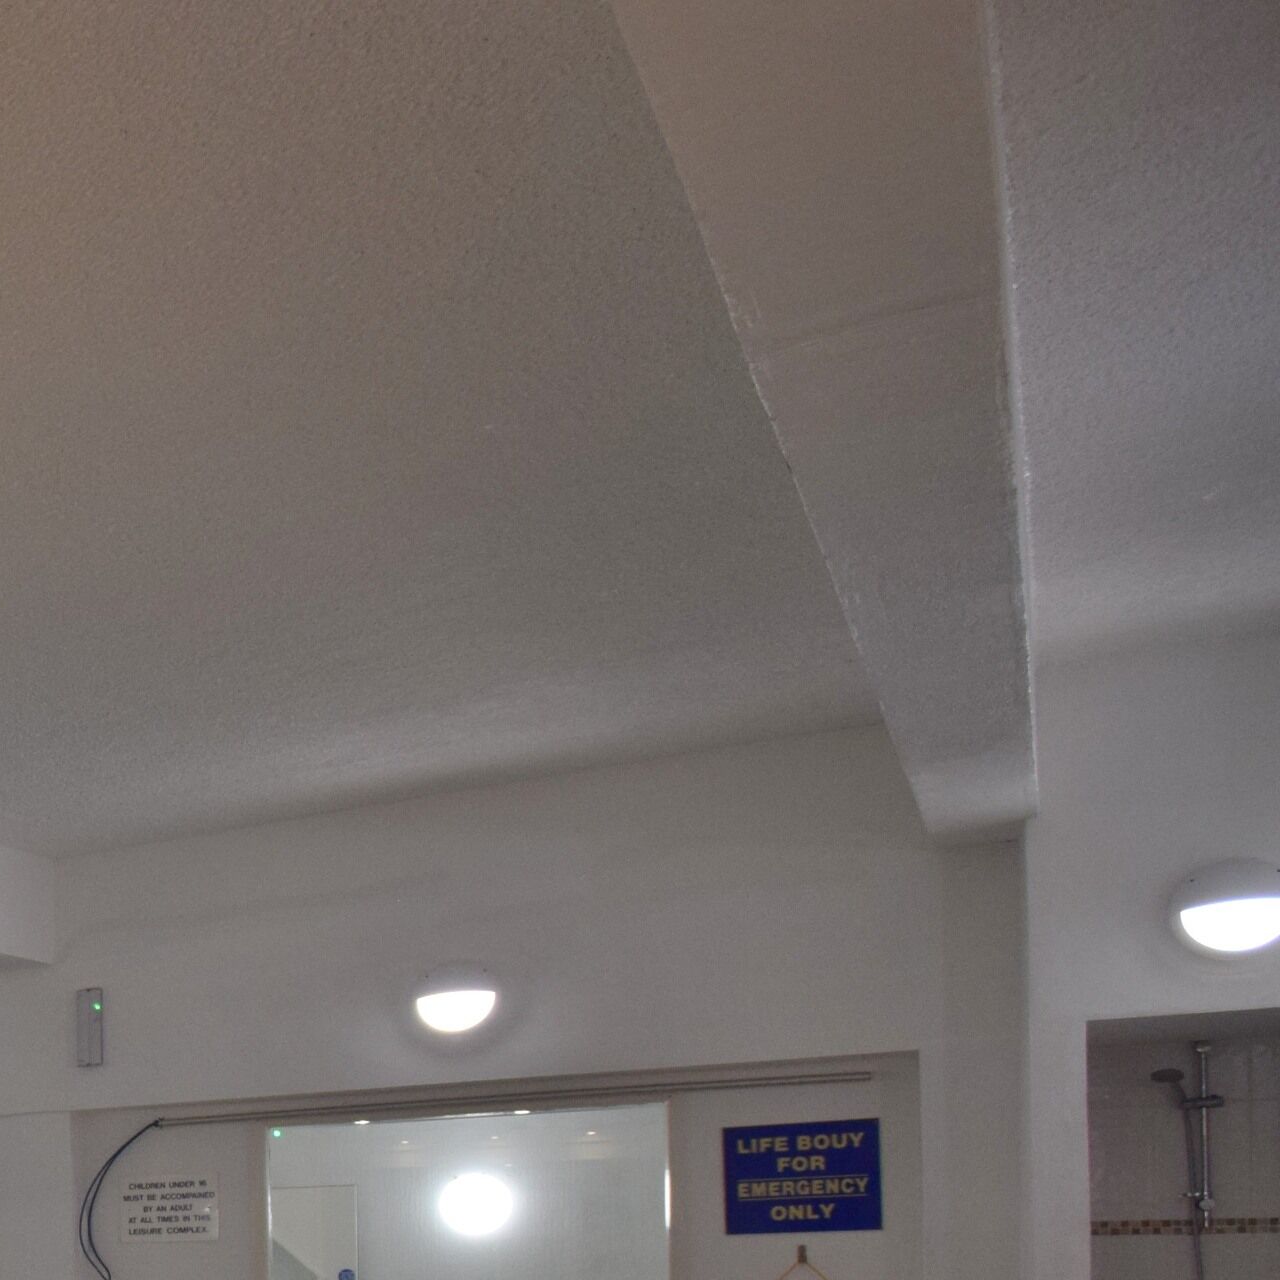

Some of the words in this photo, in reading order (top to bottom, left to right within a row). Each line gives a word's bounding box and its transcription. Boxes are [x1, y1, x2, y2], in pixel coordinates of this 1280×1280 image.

[738, 1136, 788, 1154] LIFE
[796, 1132, 864, 1150] BOUY
[777, 1156, 825, 1172] FOR
[129, 1182, 165, 1190] CHILDREN
[169, 1181, 194, 1189] UNDER
[738, 1177, 869, 1197] EMERGENCY
[123, 1194, 143, 1202] MUST
[170, 1204, 192, 1212] ADULT
[770, 1203, 835, 1221] ONLY
